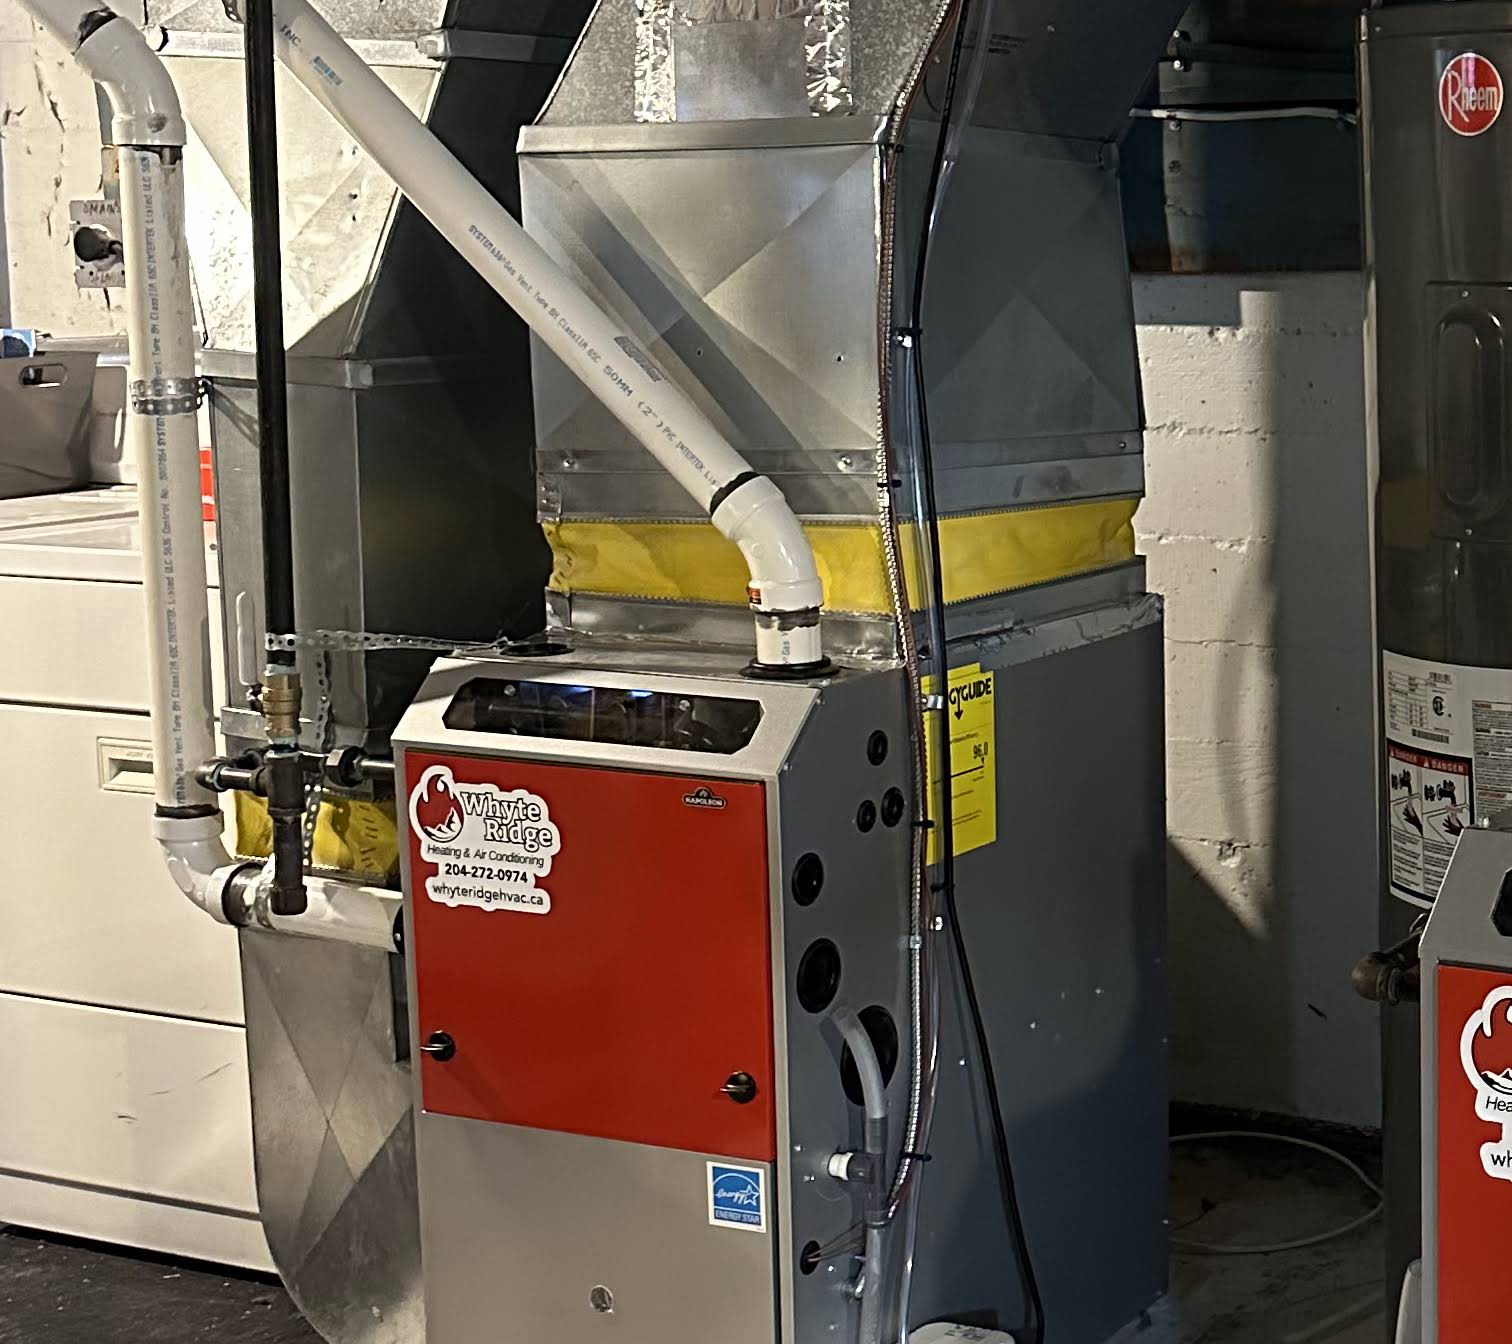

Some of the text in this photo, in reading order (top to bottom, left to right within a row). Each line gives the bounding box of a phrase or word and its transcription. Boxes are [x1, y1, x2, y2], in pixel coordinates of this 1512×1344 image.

[1447, 70, 1498, 122] Rheem
[602, 365, 633, 396] 50MM
[949, 678, 992, 706] GYGUIDE
[460, 792, 541, 824] Whyte
[484, 818, 552, 853] Ridge
[427, 844, 544, 868] Heating & Air Conditioning
[445, 863, 528, 883] 204-272-0974
[433, 883, 543, 905] whyteridgehvac.ca
